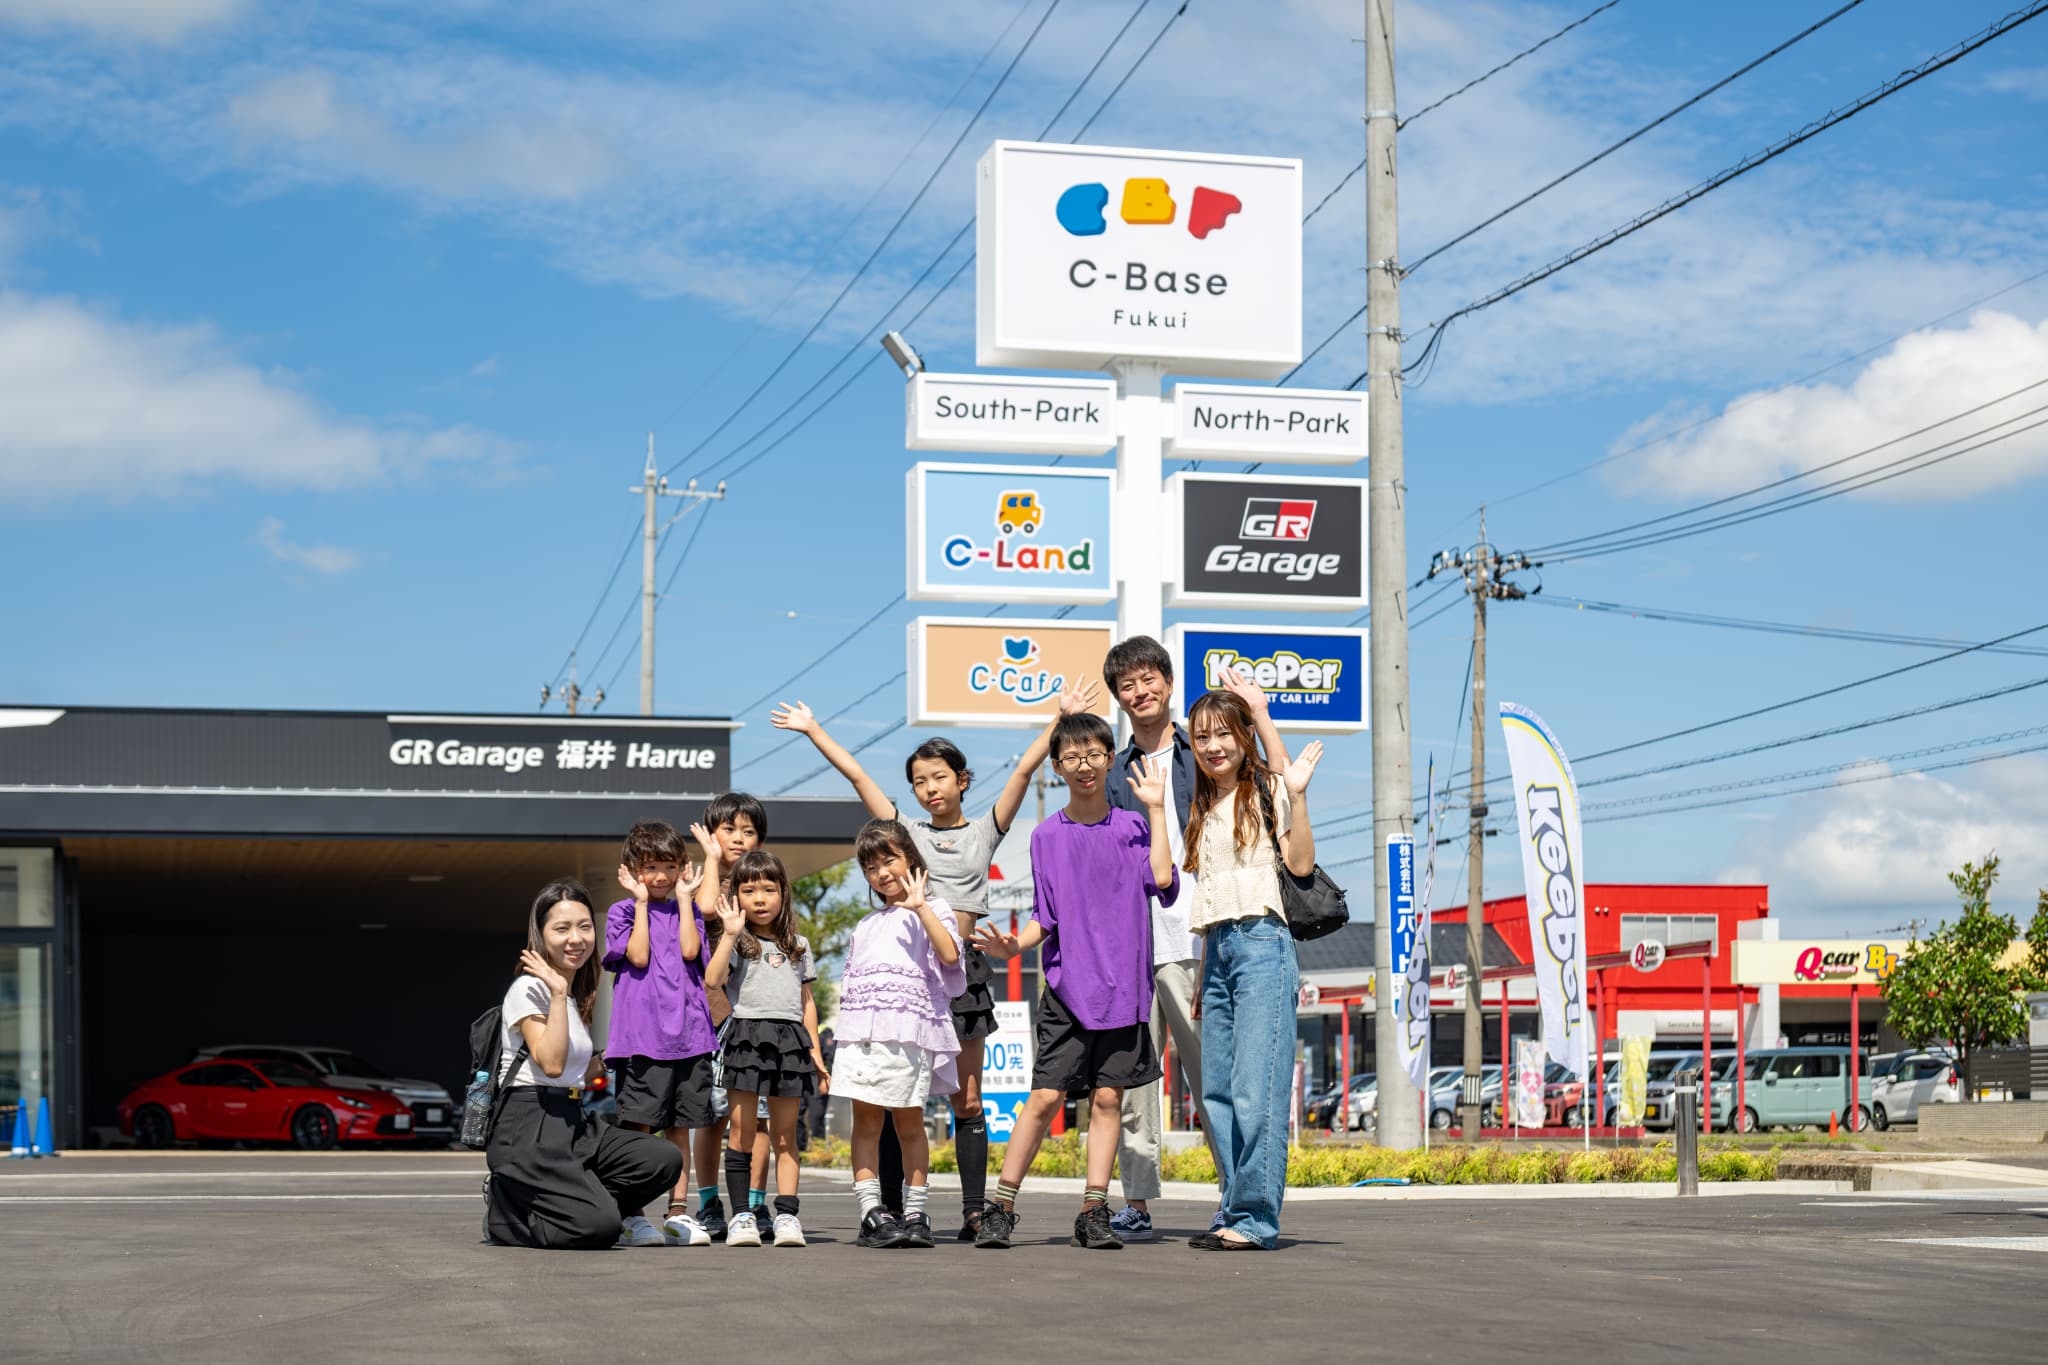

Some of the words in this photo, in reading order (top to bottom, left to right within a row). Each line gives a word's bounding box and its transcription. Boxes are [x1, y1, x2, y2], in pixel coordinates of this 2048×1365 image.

[1068, 258, 1228, 296] C-Base
[1113, 309, 1188, 329] Fukui
[935, 394, 1099, 424] South-Park
[1193, 406, 1350, 435] North-Park
[1244, 514, 1310, 538] GR
[944, 537, 1091, 571] C-Land
[1203, 544, 1342, 582] Garage
[1206, 652, 1340, 690] KeePer
[1279, 693, 1302, 705] CAR
[1304, 693, 1330, 705] LIFE
[389, 739, 433, 766] GR
[436, 739, 545, 773] Garage
[555, 739, 617, 770] 福井
[625, 742, 717, 769] Harue
